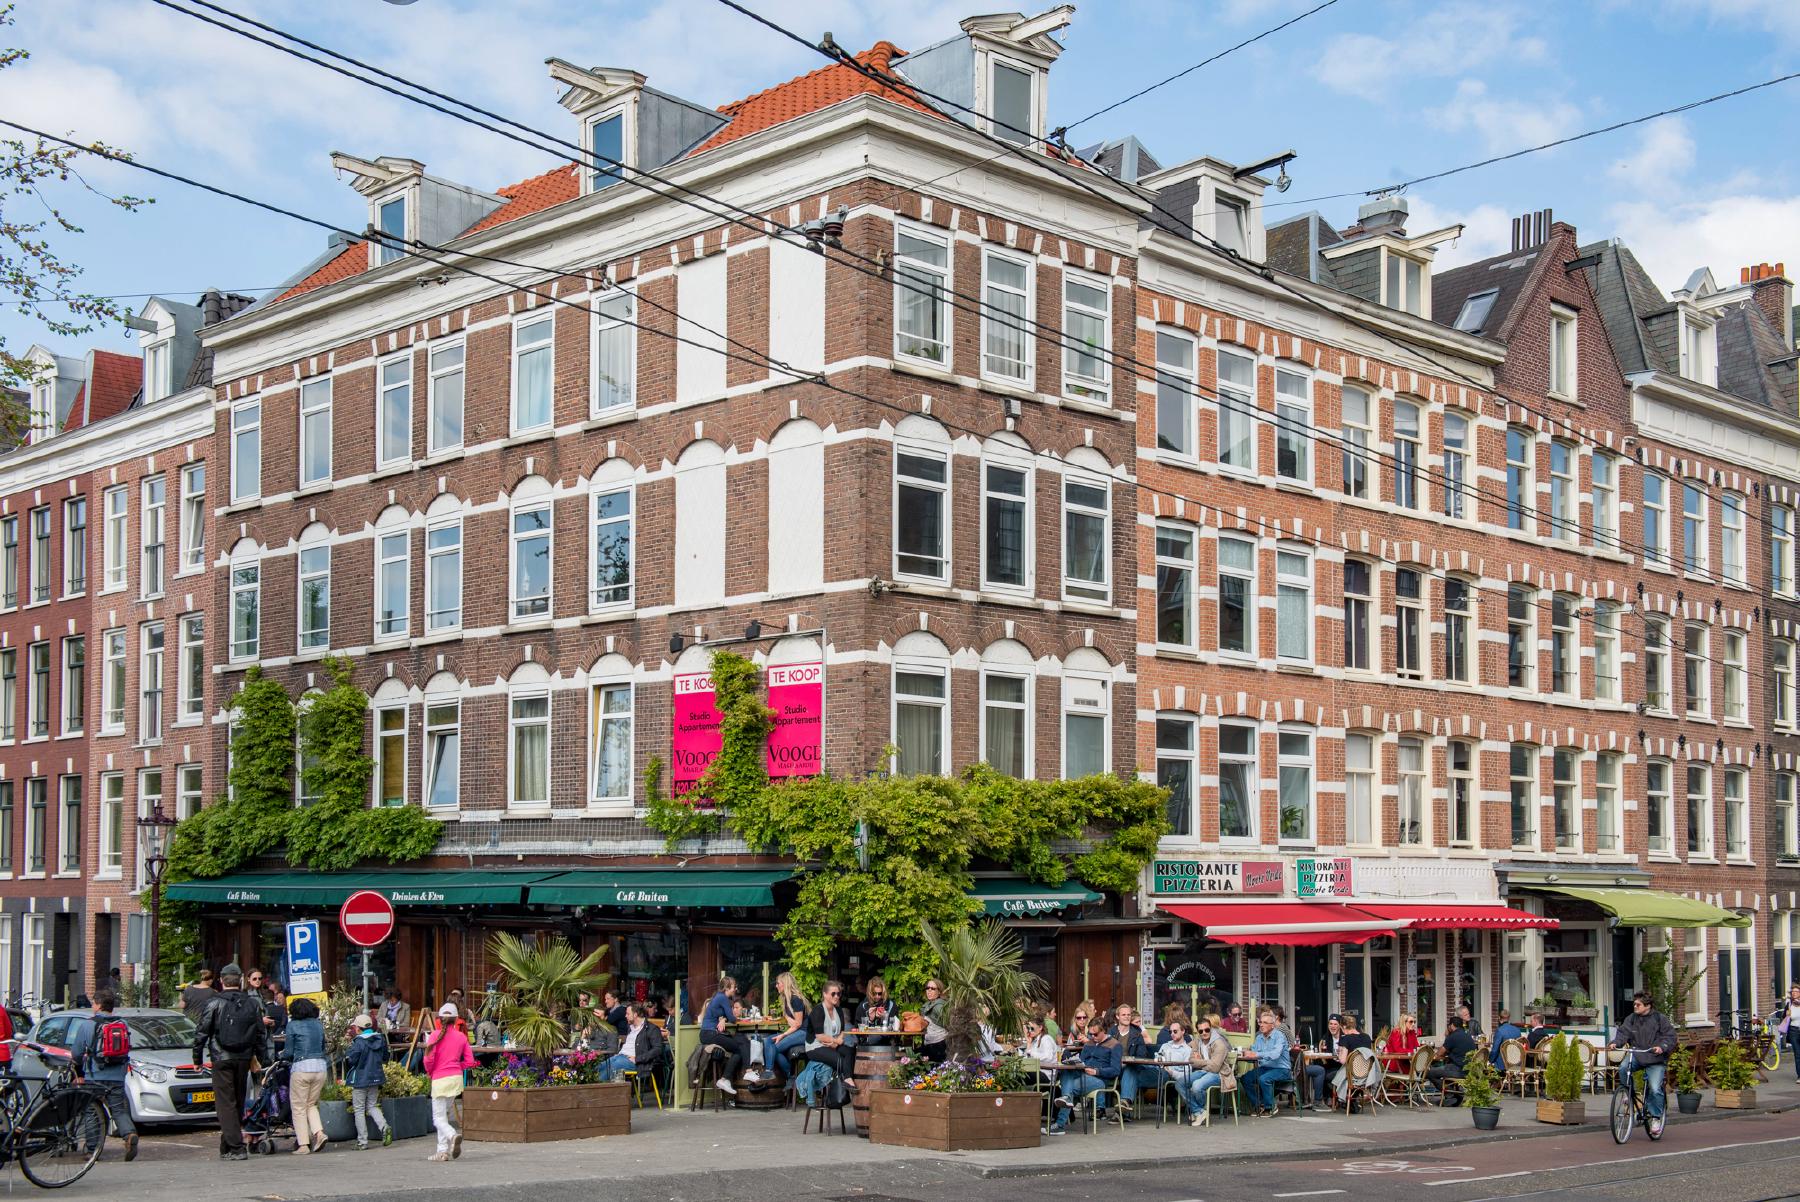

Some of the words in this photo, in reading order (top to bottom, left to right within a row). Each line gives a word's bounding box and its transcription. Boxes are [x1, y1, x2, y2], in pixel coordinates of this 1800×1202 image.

[773, 671, 785, 683] TE
[788, 668, 820, 682] KOOP
[679, 680, 690, 692] TE
[694, 677, 716, 690] KOO
[784, 704, 806, 714] Studio
[689, 712, 710, 721] Studio
[679, 722, 721, 734] Appartemen
[1156, 863, 1238, 877] RISTORANTE
[1299, 862, 1348, 871] RISTORANTE
[1303, 873, 1346, 882] PIZZERIA
[1163, 879, 1234, 891] PIZZERIA
[1301, 885, 1326, 893] Monte
[1328, 885, 1349, 893] Verde
[391, 891, 419, 900] Drinken
[420, 891, 427, 900] &
[428, 891, 444, 900] Eten
[616, 890, 636, 901] Café
[637, 891, 668, 902] Buiten
[1003, 900, 1025, 911] Café
[1026, 899, 1061, 910] Buiten
[294, 926, 311, 954] P
